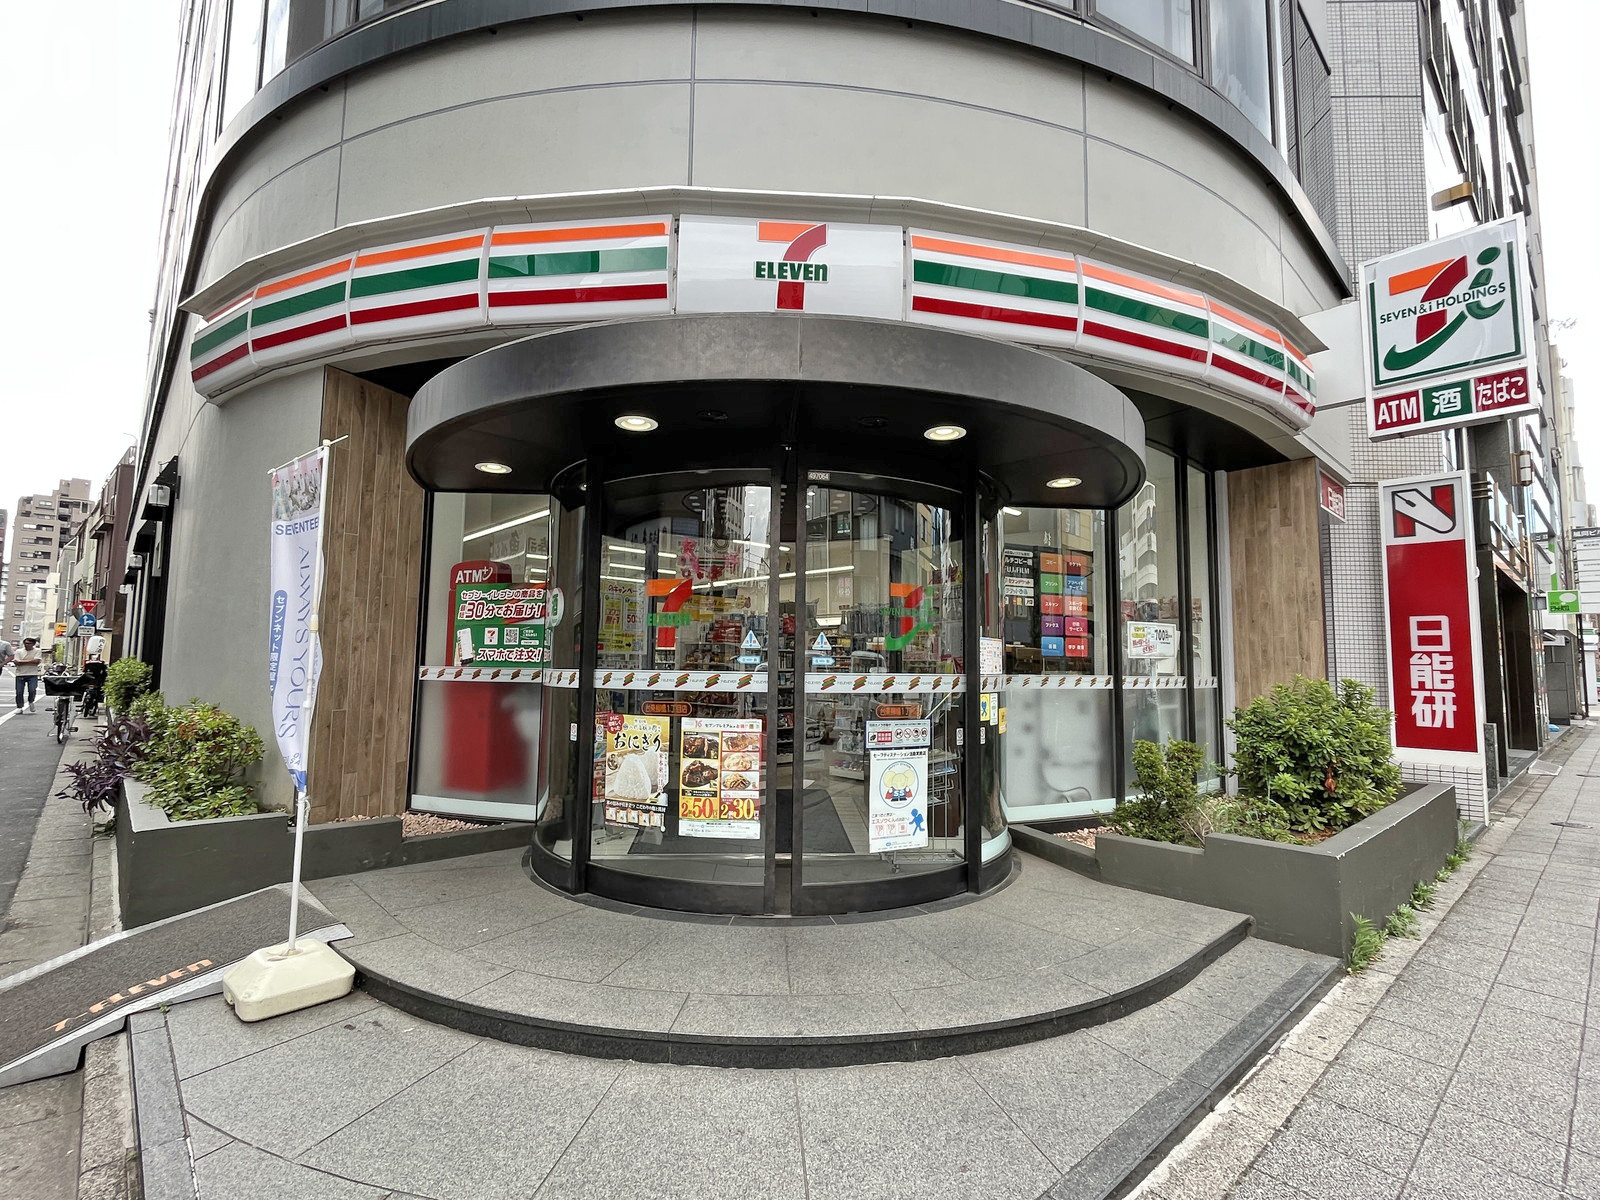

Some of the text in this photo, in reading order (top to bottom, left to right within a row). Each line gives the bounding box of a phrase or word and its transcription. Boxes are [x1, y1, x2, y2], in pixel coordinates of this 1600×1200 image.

[1436, 282, 1506, 310] HOLDINGS
[1432, 387, 1462, 417] 酒
[1476, 377, 1527, 406] たばこ
[1377, 396, 1418, 425] ATM
[455, 569, 482, 584] ATM
[1408, 614, 1457, 729] 日能研
[278, 648, 307, 738] YOURS
[614, 733, 661, 752] おにぎり
[733, 798, 755, 820] 30
